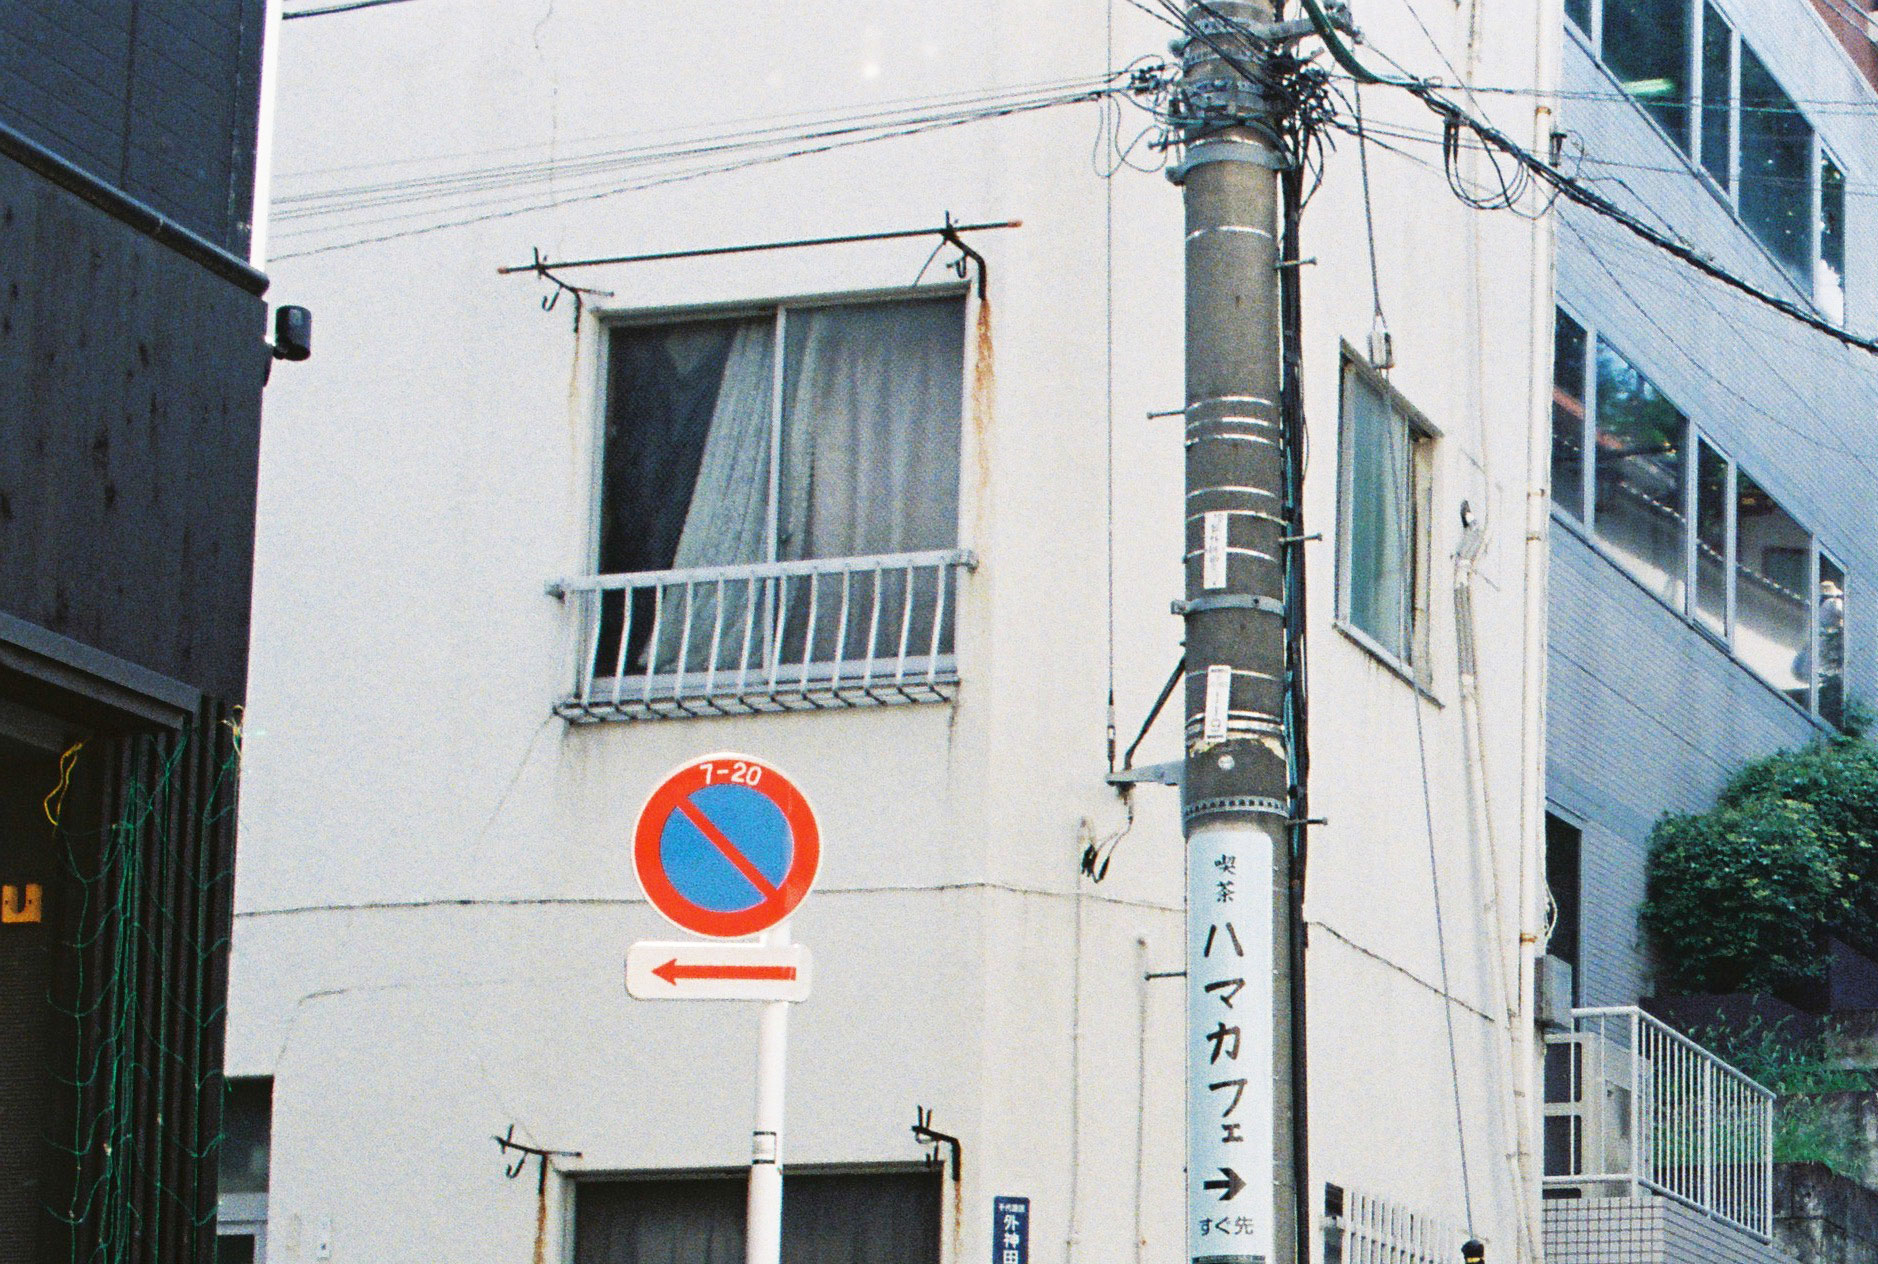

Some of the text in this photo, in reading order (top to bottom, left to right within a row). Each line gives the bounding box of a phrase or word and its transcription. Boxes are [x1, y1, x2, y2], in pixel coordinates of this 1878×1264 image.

[700, 763, 762, 786] 7-20
[1204, 853, 1248, 1143] 喫茶 ハマカフェ
[1200, 1216, 1254, 1236] すぐ先
